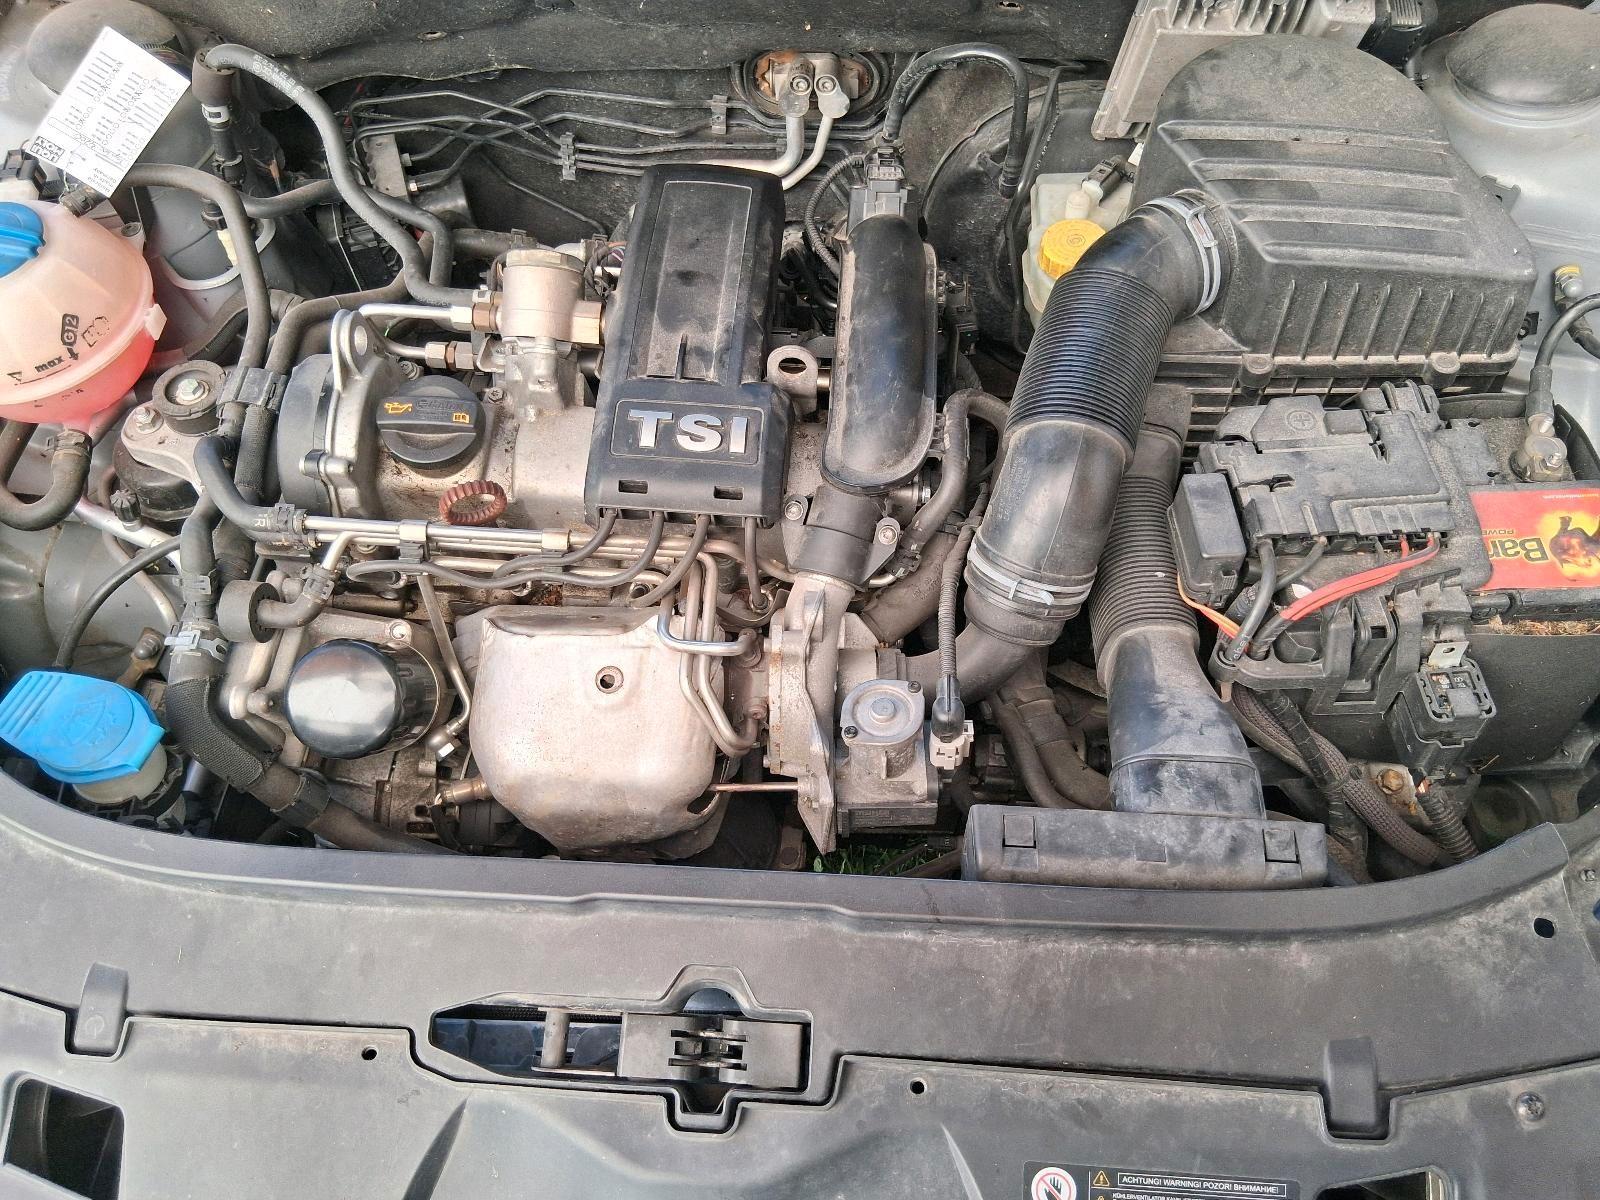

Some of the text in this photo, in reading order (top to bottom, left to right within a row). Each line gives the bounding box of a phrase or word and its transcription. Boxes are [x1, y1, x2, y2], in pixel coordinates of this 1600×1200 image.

[31, 144, 58, 162] LIQUI
[36, 137, 64, 155] MOLY
[62, 316, 78, 345] G12
[34, 356, 65, 373] max
[628, 409, 749, 454] TSI
[1122, 1176, 1279, 1194] ACHTUNG! WARNING! POZOR! ВНИМАНИЕ!
